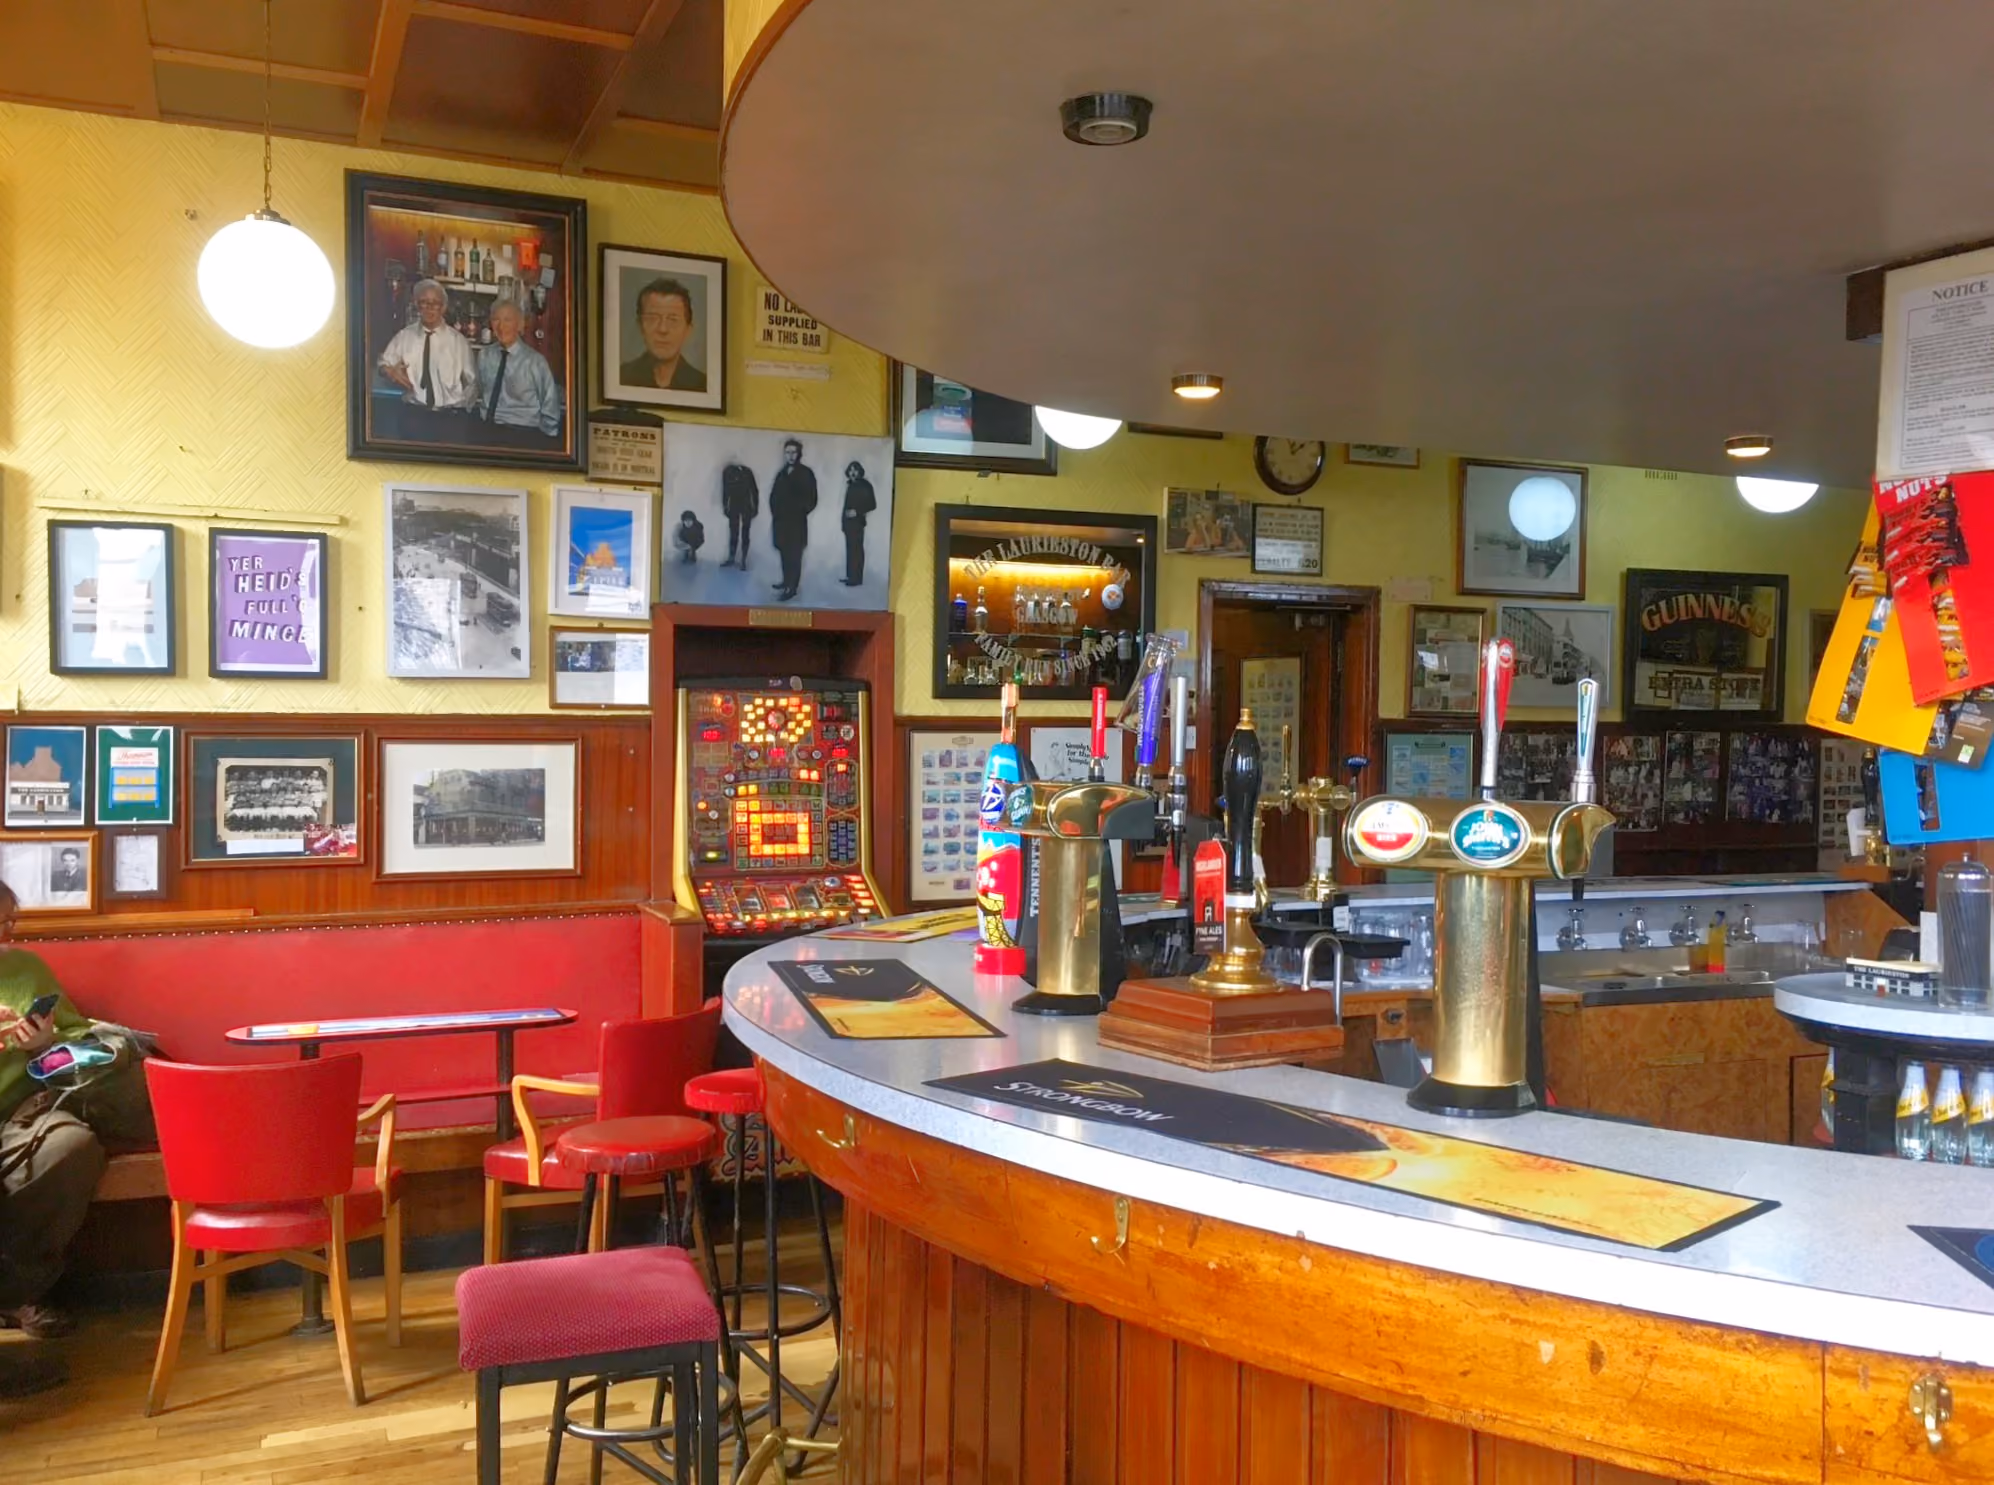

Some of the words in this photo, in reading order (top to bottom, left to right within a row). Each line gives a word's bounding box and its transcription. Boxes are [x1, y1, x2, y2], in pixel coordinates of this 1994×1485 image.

[1932, 280, 1989, 302] NOTICE
[764, 292, 780, 311] NO
[768, 315, 818, 330] SUPPLIED
[763, 329, 773, 342] IN
[777, 330, 798, 345] THIS
[802, 333, 821, 347] BAR
[593, 427, 657, 441] PATRONS
[1895, 472, 1947, 503] NUTS
[228, 554, 264, 572] YER
[964, 549, 998, 580] THE
[997, 535, 1103, 566] LAURIESTON
[1102, 553, 1131, 591] BAR
[234, 566, 307, 593] HEID'S
[244, 599, 289, 615] FULL
[1016, 606, 1079, 625] GLASGOW
[1640, 592, 1773, 639] GUINNESS
[229, 619, 309, 643] MINCE
[1053, 651, 1091, 675] SINCE
[1648, 676, 1705, 691] EXTRA
[1029, 838, 1041, 918] TENNENT'S
[1208, 925, 1222, 935] ALES
[993, 1081, 1175, 1121] STRONGBOW
